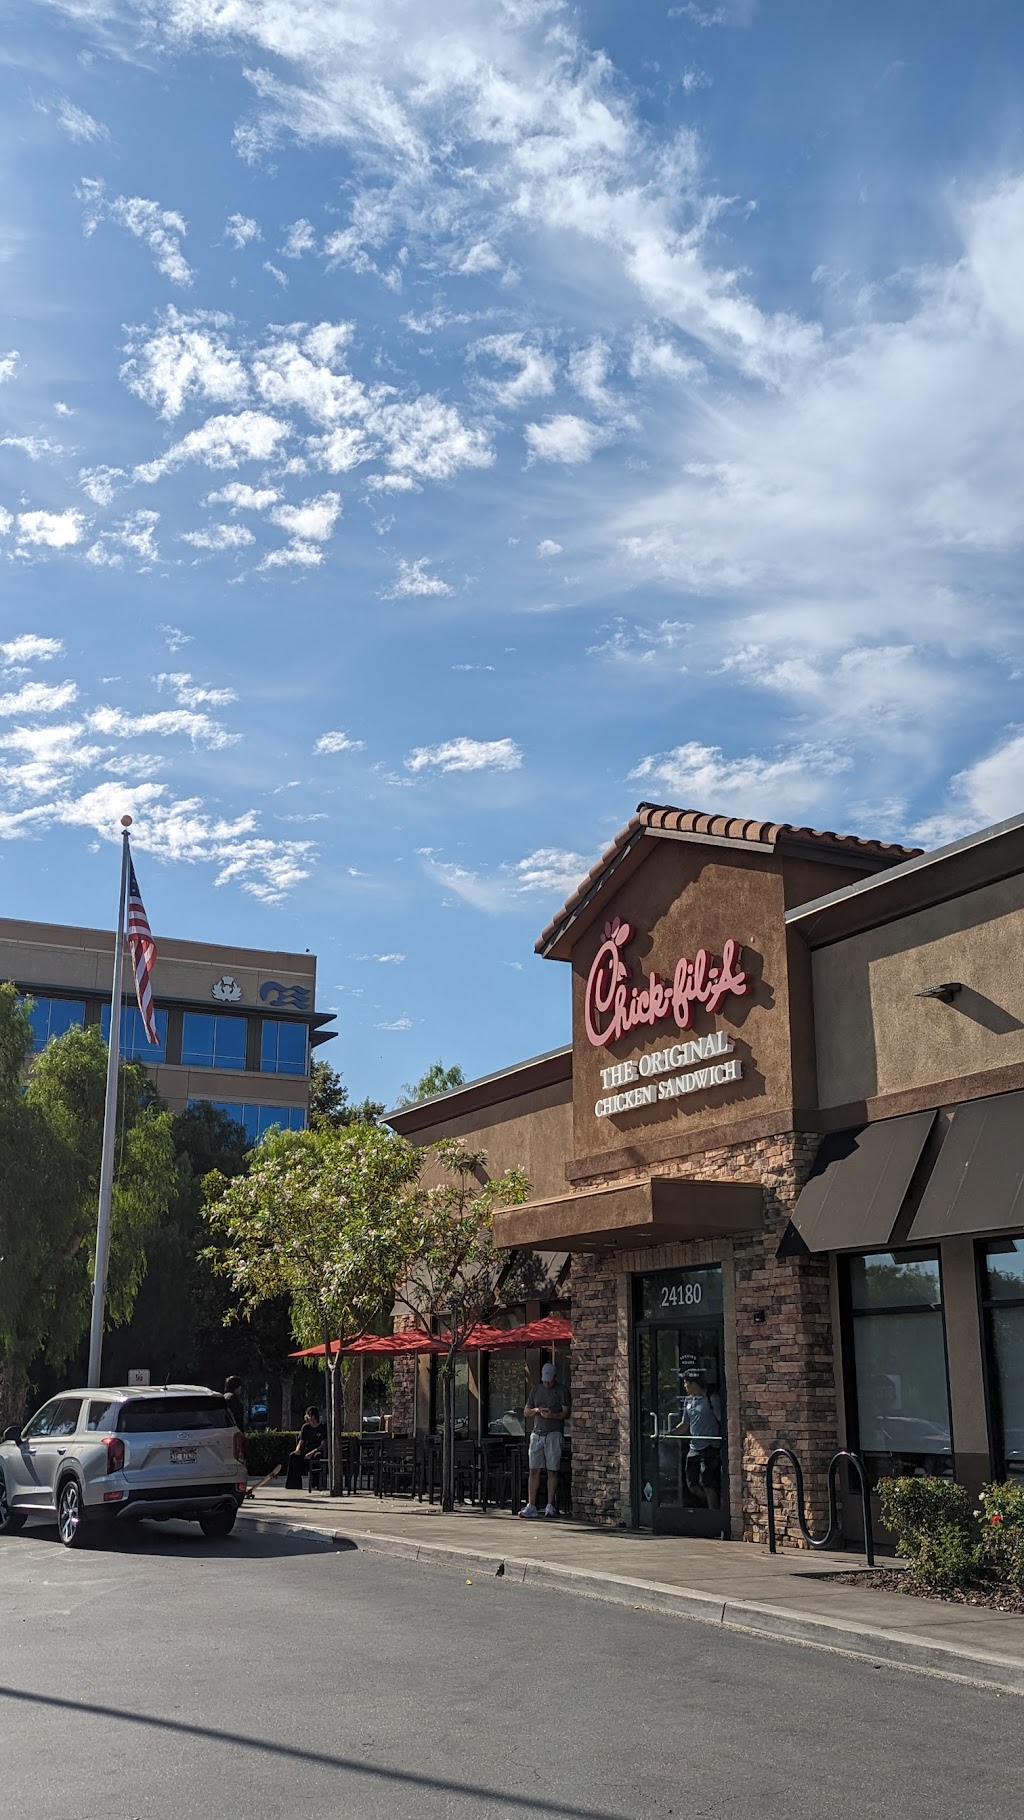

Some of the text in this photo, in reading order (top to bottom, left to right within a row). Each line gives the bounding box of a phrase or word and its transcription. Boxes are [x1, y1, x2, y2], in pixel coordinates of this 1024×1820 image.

[585, 938, 748, 1047] Chick-fil-A
[594, 1060, 739, 1118] CHICKEN SANDWICH
[600, 1031, 731, 1090] THE ORIGINAL
[661, 1283, 702, 1307] 24180
